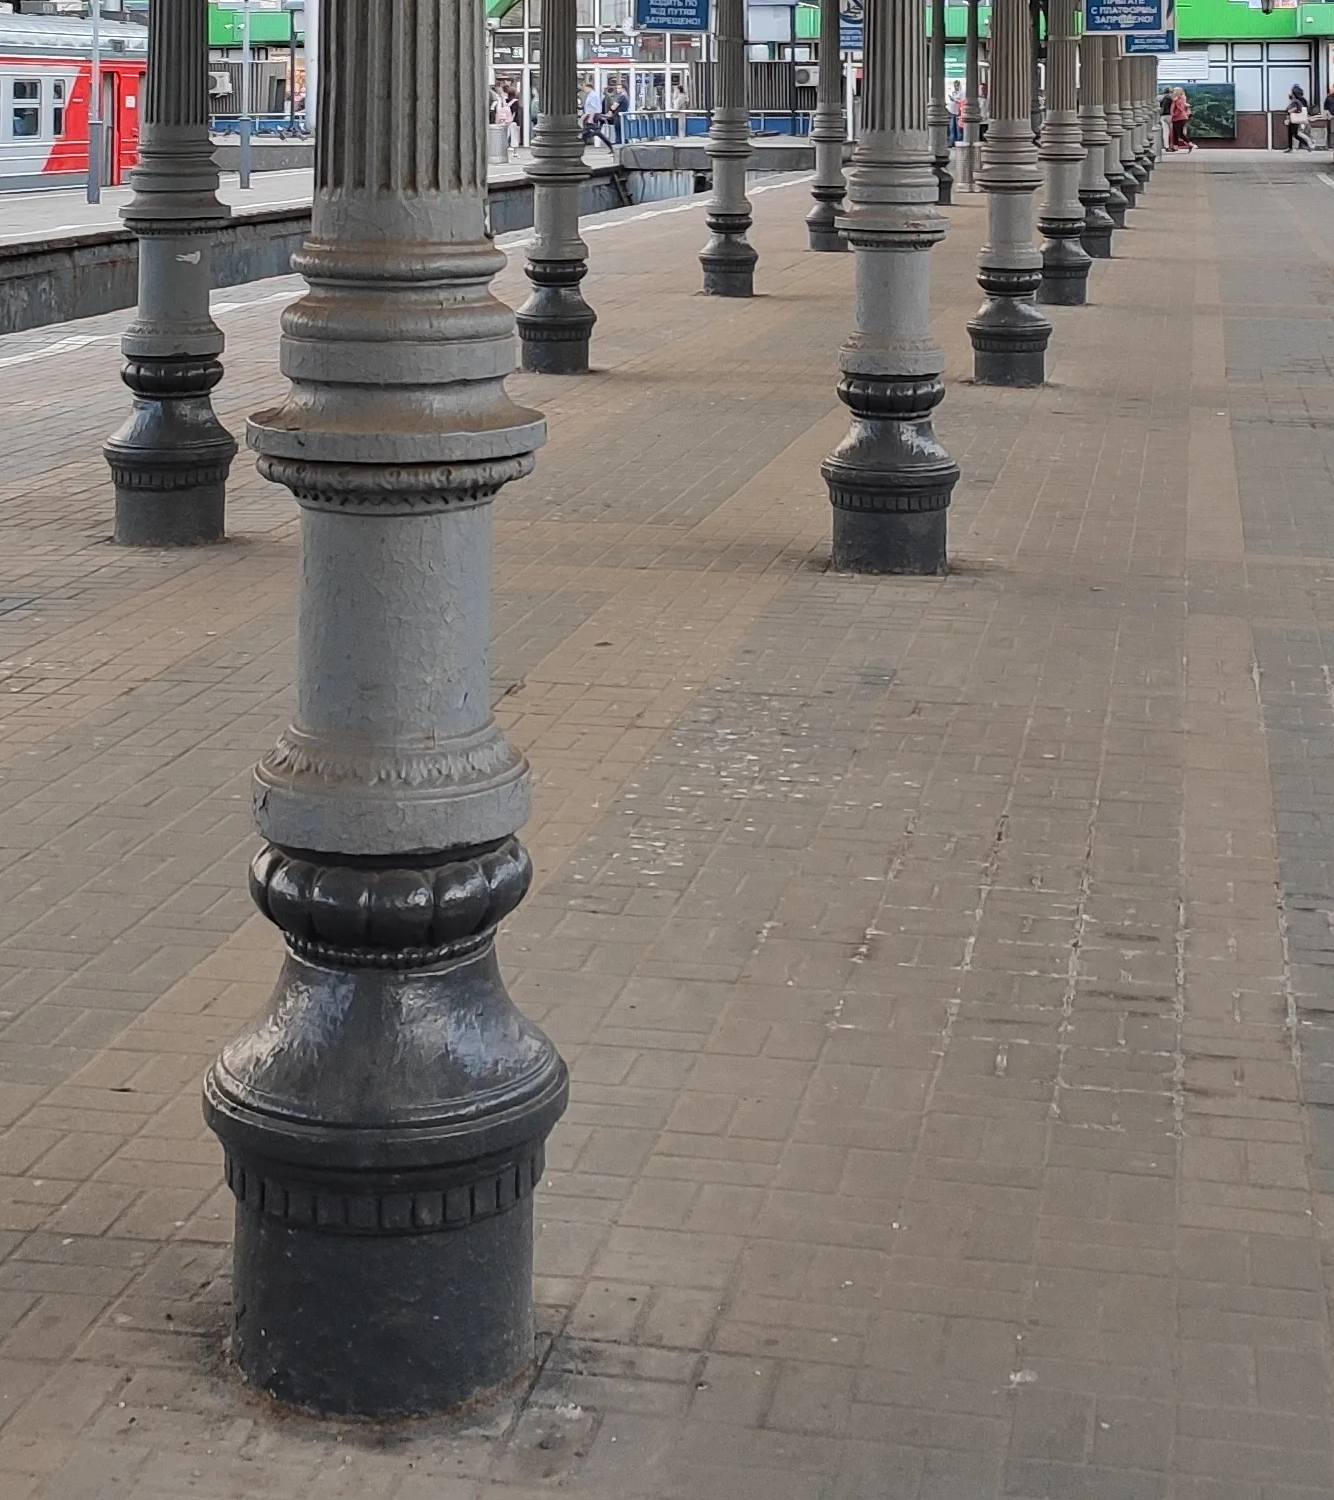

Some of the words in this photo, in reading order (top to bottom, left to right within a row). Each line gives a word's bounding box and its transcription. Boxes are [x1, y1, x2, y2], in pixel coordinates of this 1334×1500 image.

[684, 0, 698, 7] ПО
[667, 8, 696, 16] ПУТЯМ
[1099, 6, 1157, 14] ПЛАТФОРМЫ
[645, 16, 701, 25] ЗАПРЕЩЕНО!
